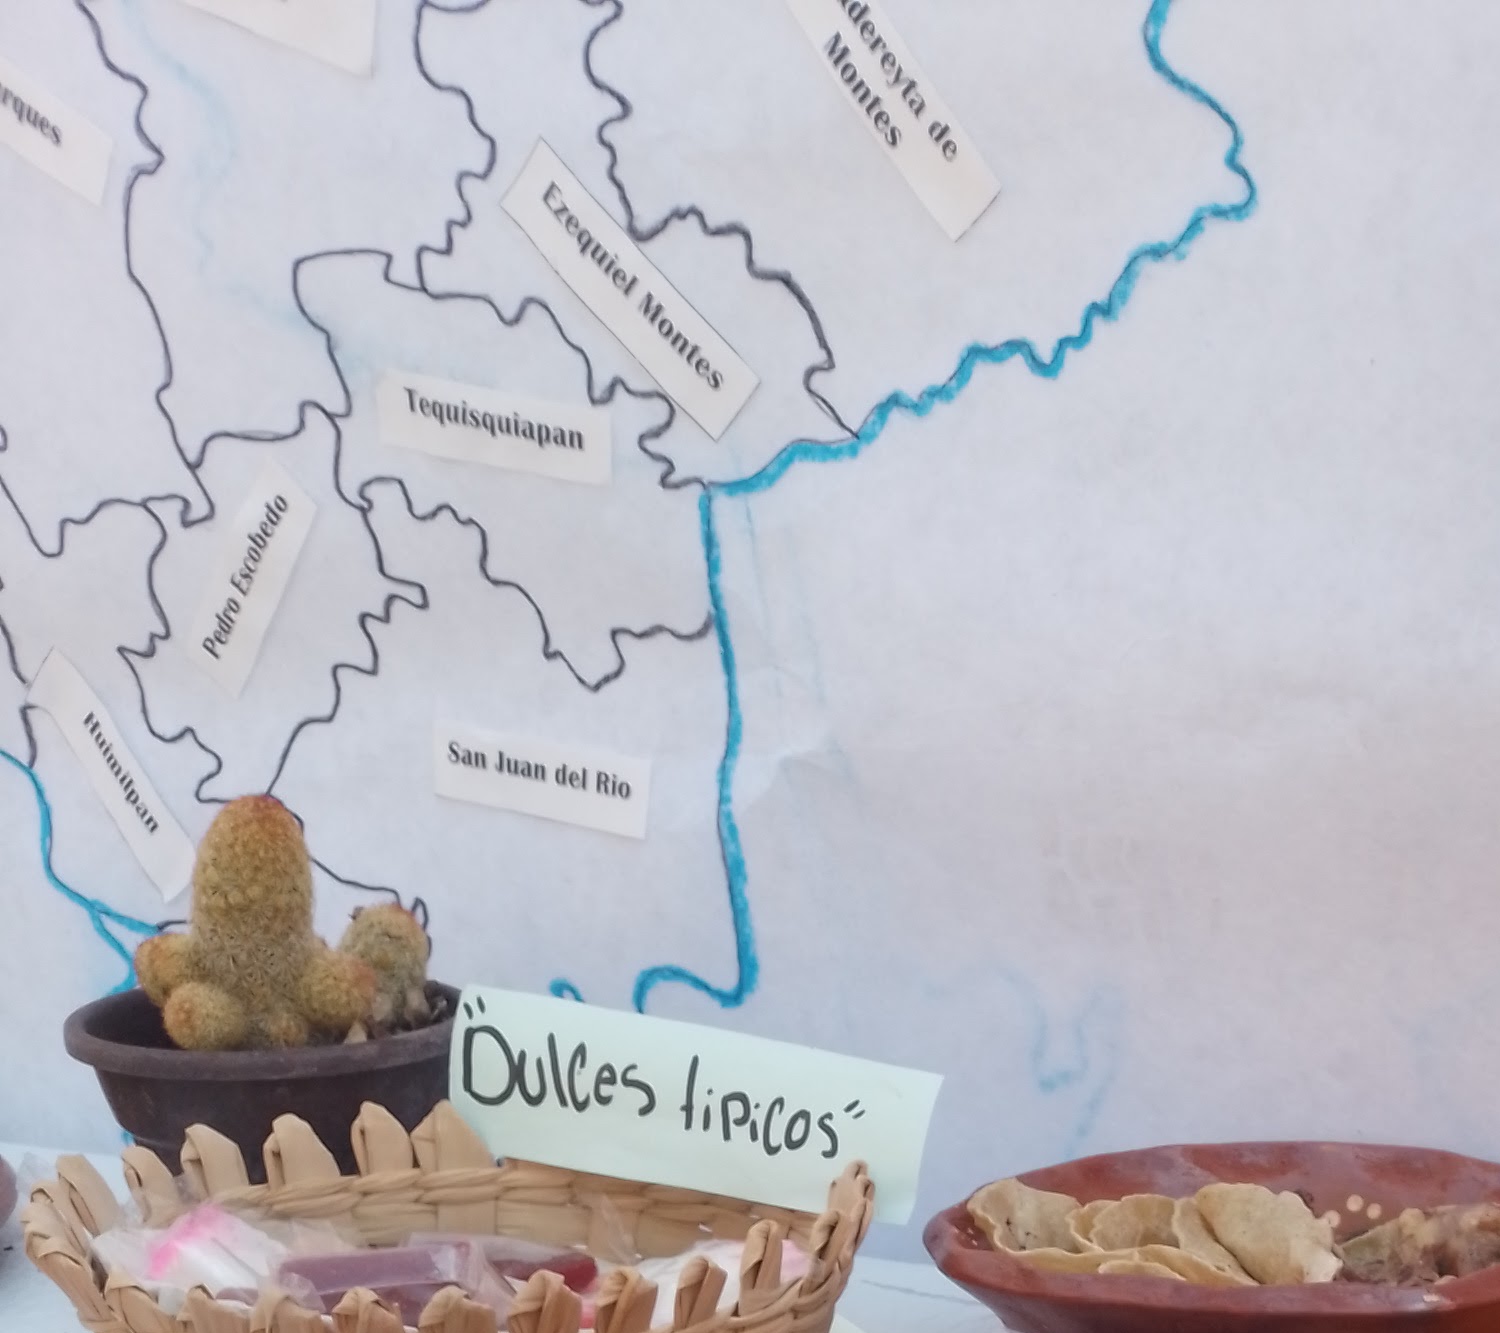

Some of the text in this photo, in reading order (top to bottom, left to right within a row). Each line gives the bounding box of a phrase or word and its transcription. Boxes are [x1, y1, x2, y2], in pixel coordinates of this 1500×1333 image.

[0, 81, 62, 147] rques
[823, 31, 903, 150] Montes
[927, 119, 958, 163] de
[542, 180, 724, 391] Ezequiel Montes
[403, 386, 586, 450] Tequisquiapan
[202, 494, 288, 660] Pedro Escobedo
[82, 711, 160, 835] Huimilpan
[448, 741, 632, 799] San Juan del Rio
